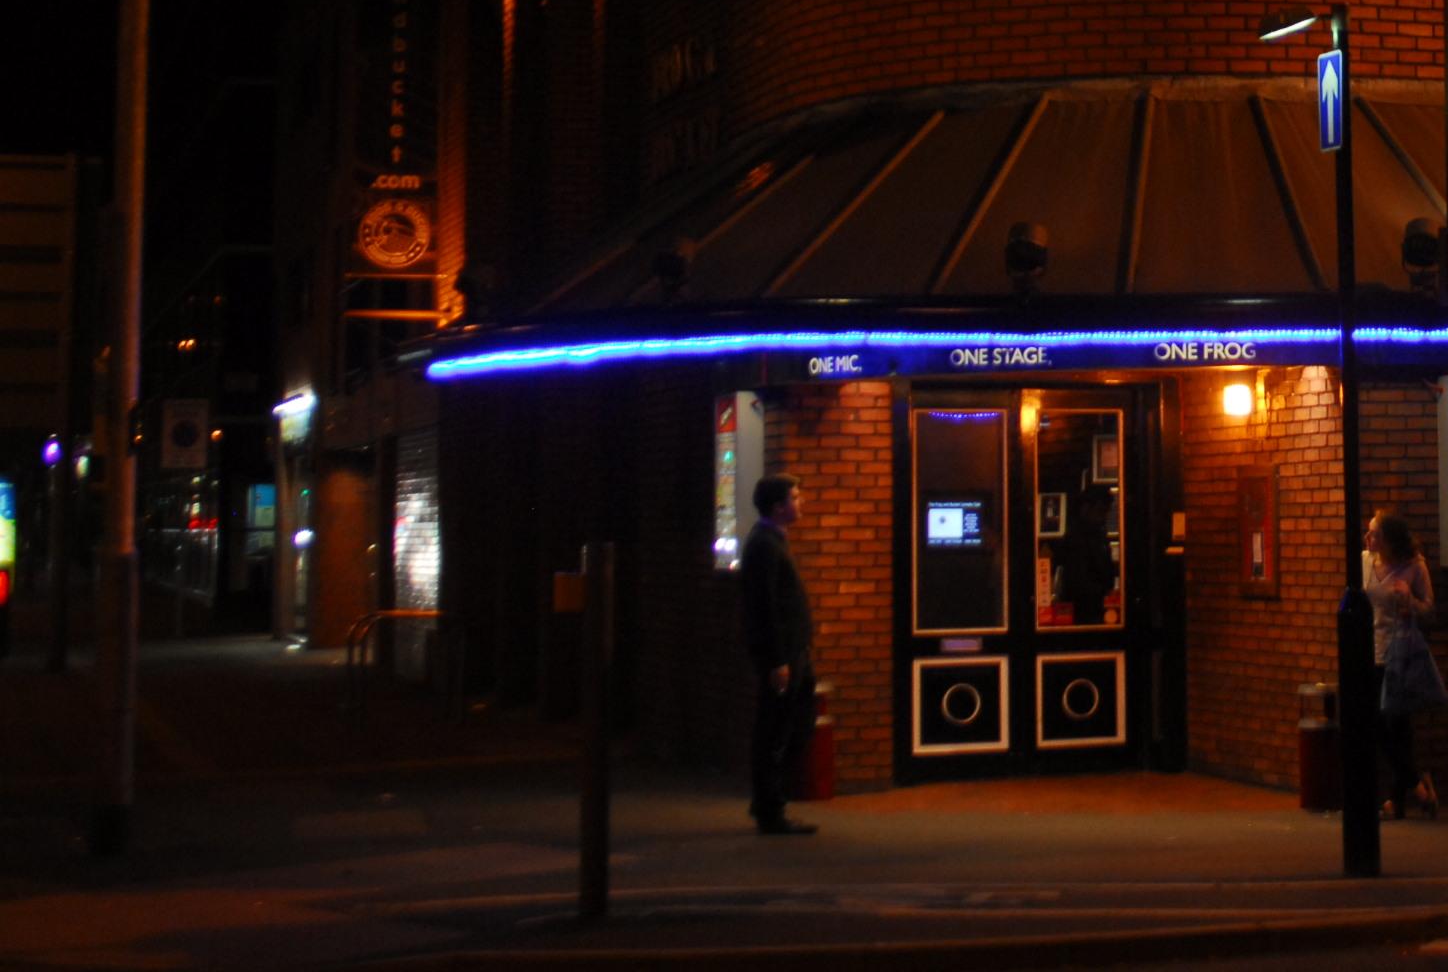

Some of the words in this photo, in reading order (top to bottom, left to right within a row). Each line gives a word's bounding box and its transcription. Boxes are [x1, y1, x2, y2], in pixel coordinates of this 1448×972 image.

[808, 356, 833, 376] ONE
[949, 348, 989, 367] ONE
[1153, 342, 1198, 361] ONE
[1202, 340, 1257, 361] FROG
